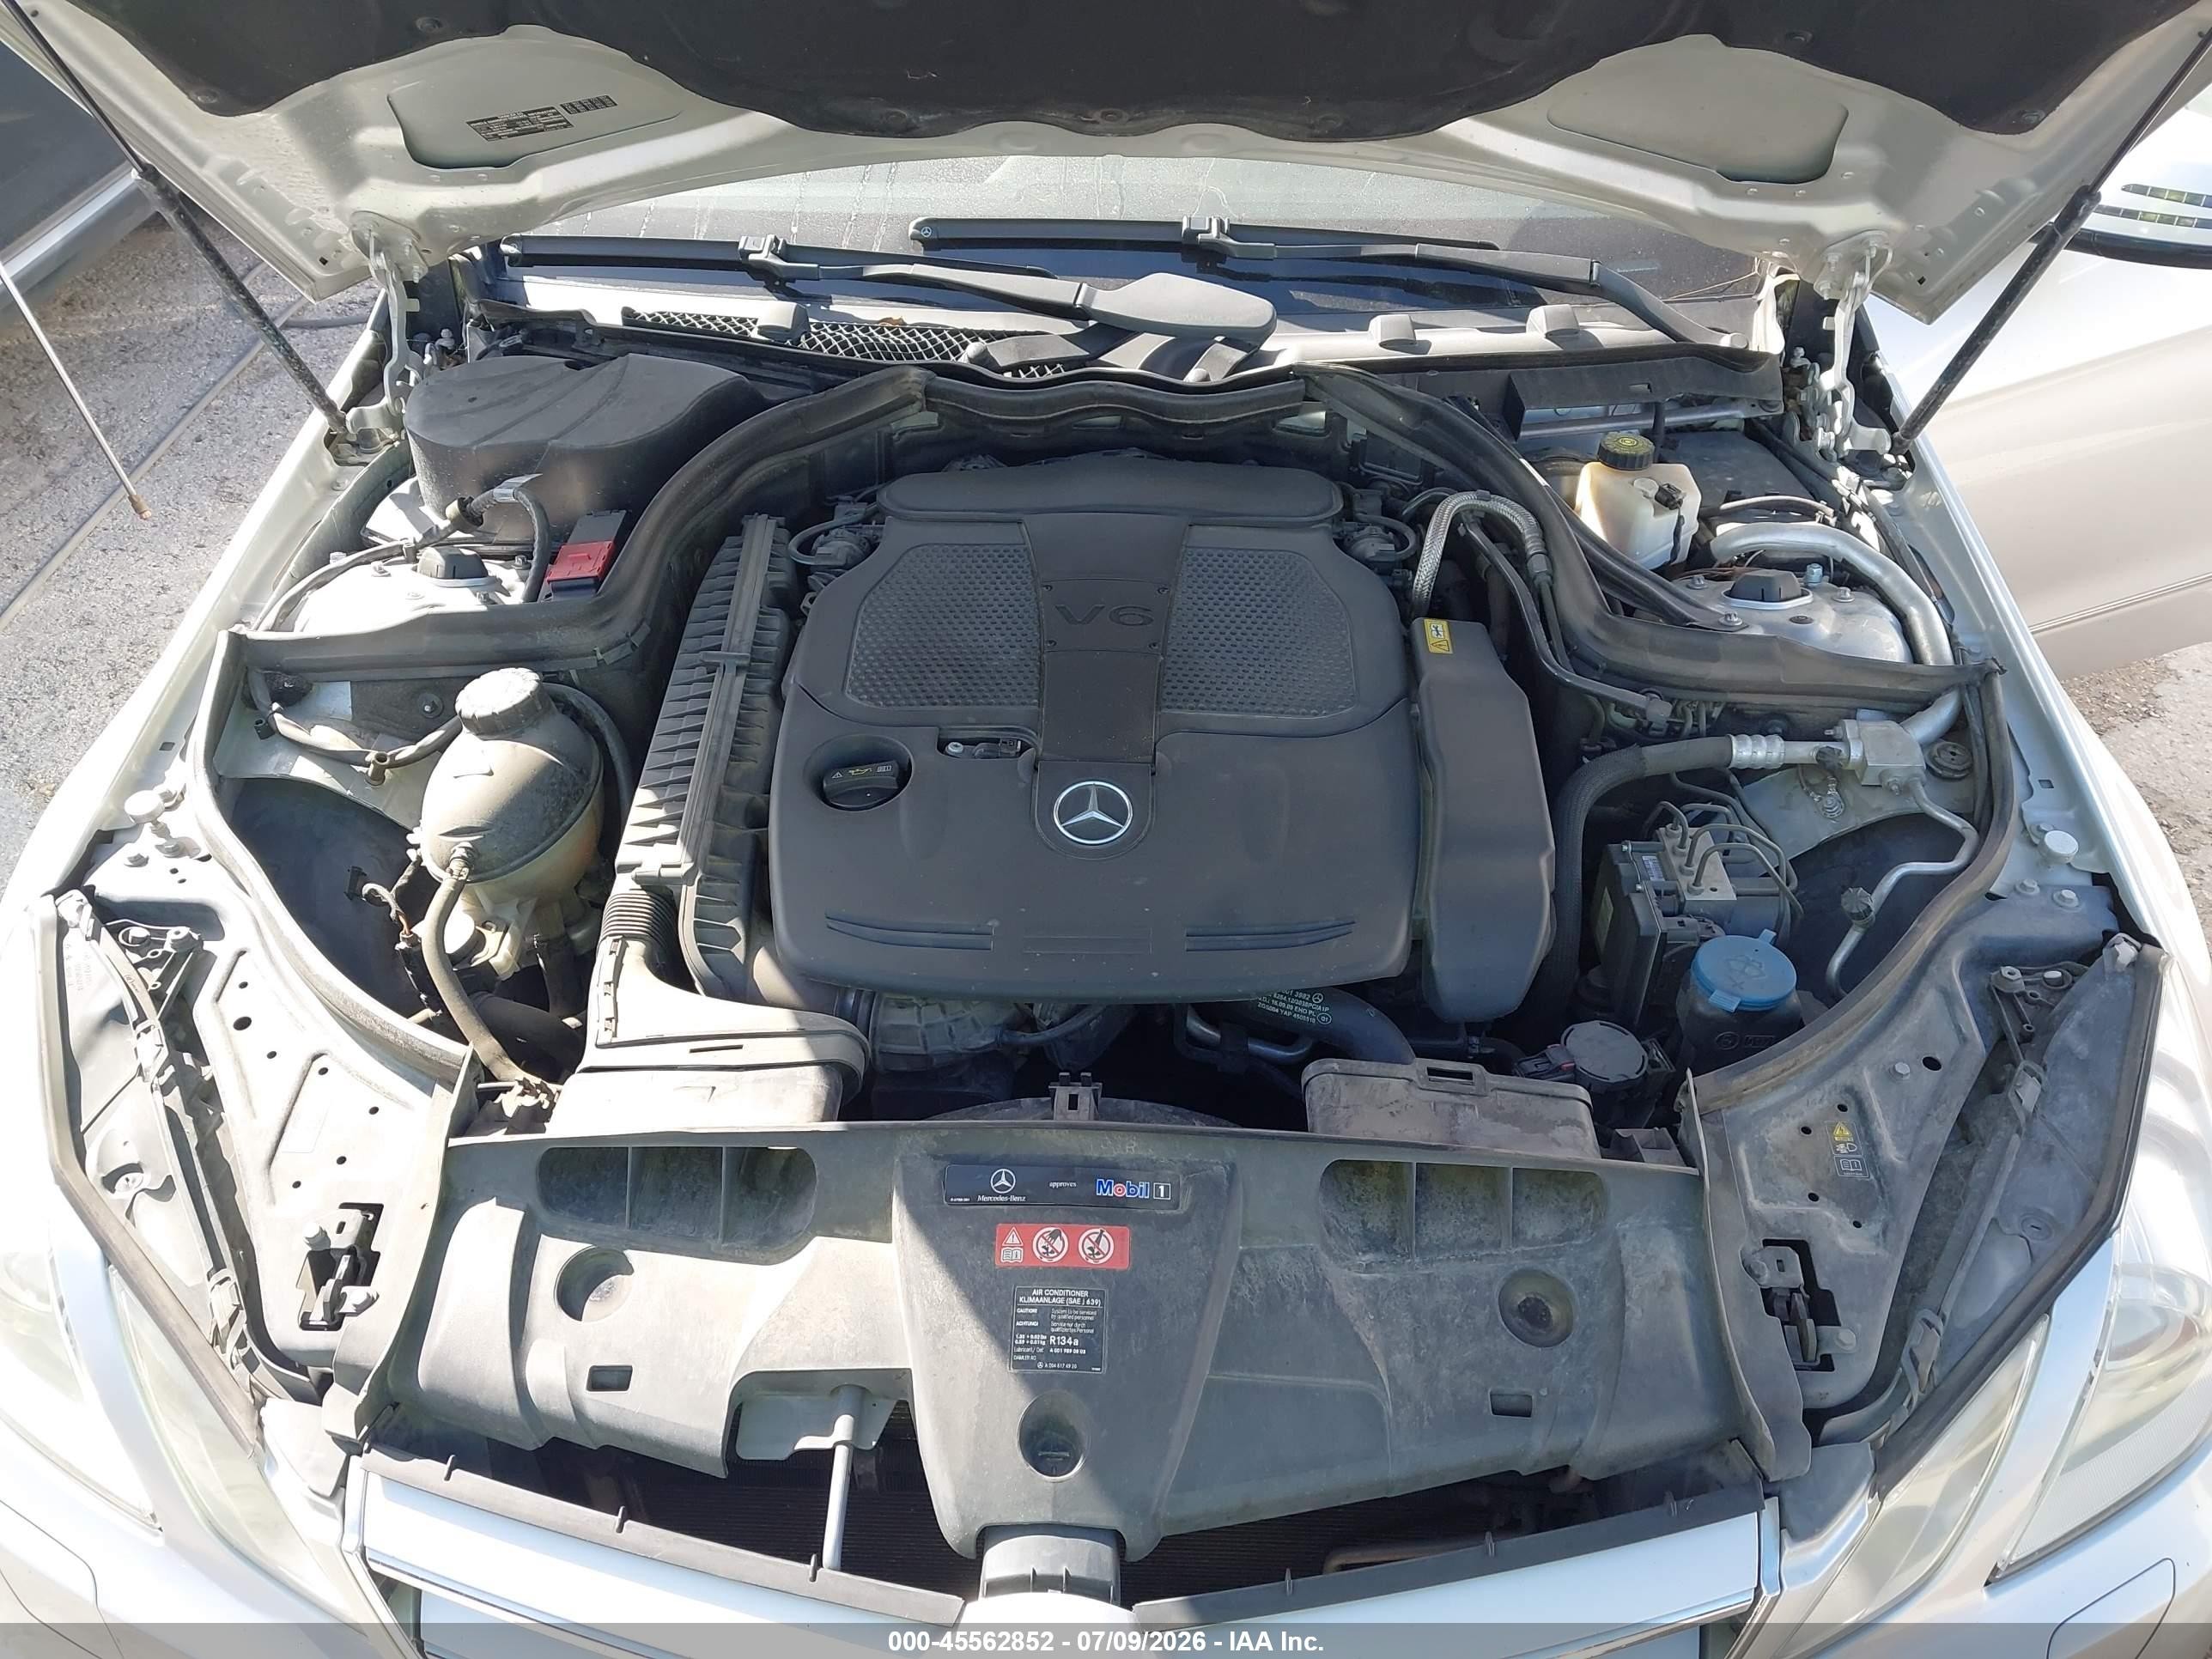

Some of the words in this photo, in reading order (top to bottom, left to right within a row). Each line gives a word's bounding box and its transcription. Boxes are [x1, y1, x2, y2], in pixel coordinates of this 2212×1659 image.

[1055, 604, 1154, 626] V6
[1096, 1179, 1150, 1199] Mobil
[1044, 1289, 1089, 1297] CONDITIONER
[1018, 1296, 1066, 1304] KLIMAANLAGE
[1066, 1297, 1081, 1306] (SAE
[1086, 1298, 1102, 1308] 639)
[1049, 1335, 1079, 1346] R134a
